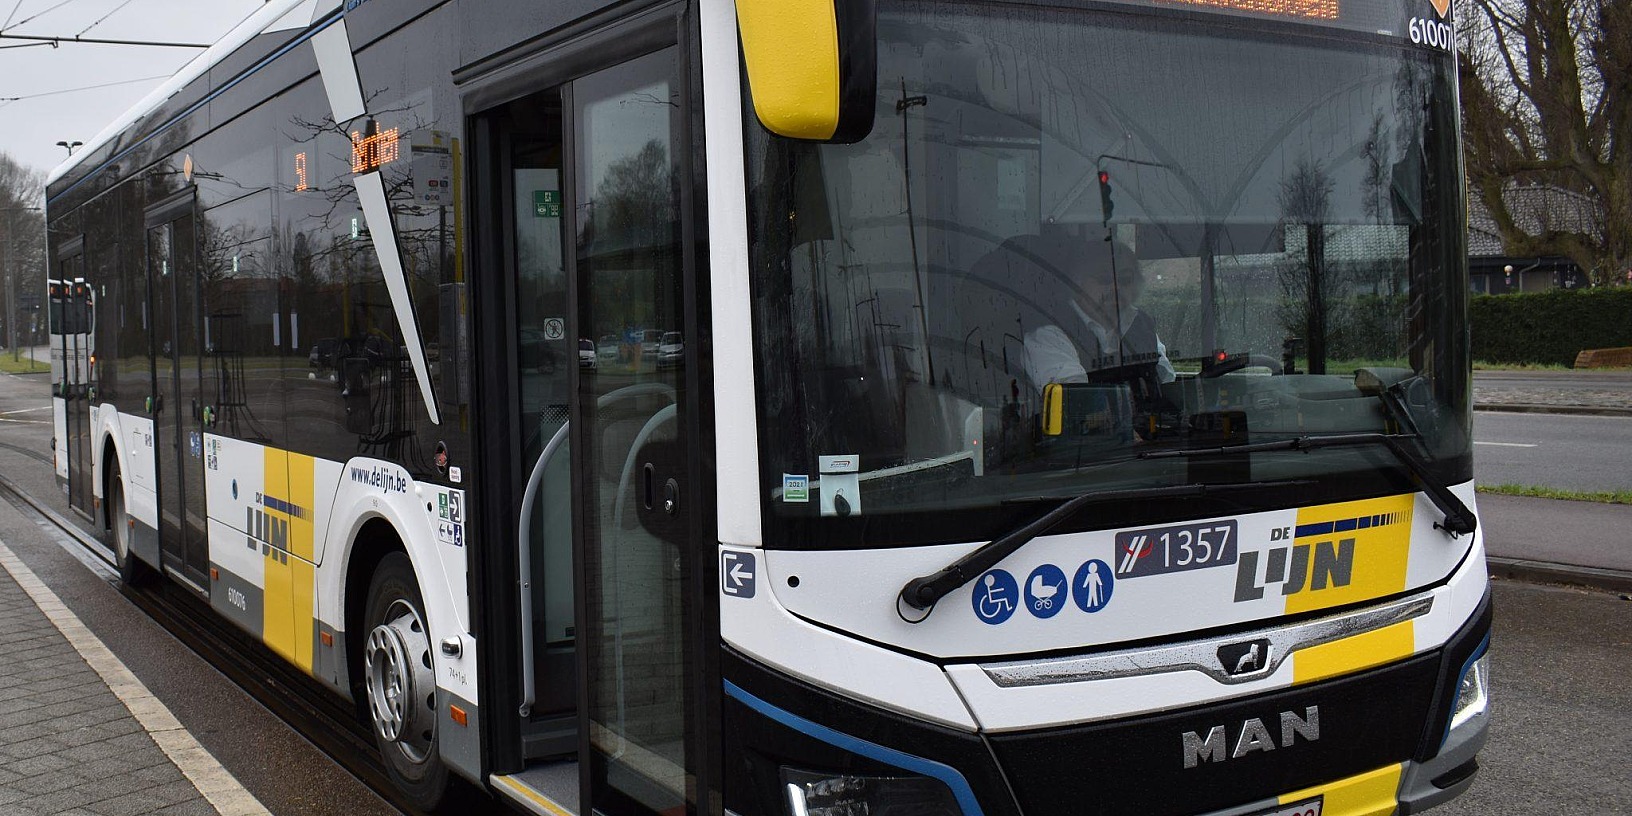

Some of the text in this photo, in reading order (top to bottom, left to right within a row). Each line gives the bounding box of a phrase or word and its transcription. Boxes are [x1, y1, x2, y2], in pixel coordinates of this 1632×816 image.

[351, 121, 398, 173] Berchem
[255, 491, 263, 505] DE
[350, 465, 407, 493] www.delijn.be
[247, 506, 287, 566] LIJN
[1160, 526, 1232, 567] 1357
[1270, 526, 1291, 541] DE
[1234, 538, 1355, 603] LIJN
[228, 587, 246, 611] 610076
[1181, 705, 1320, 769] MAN
